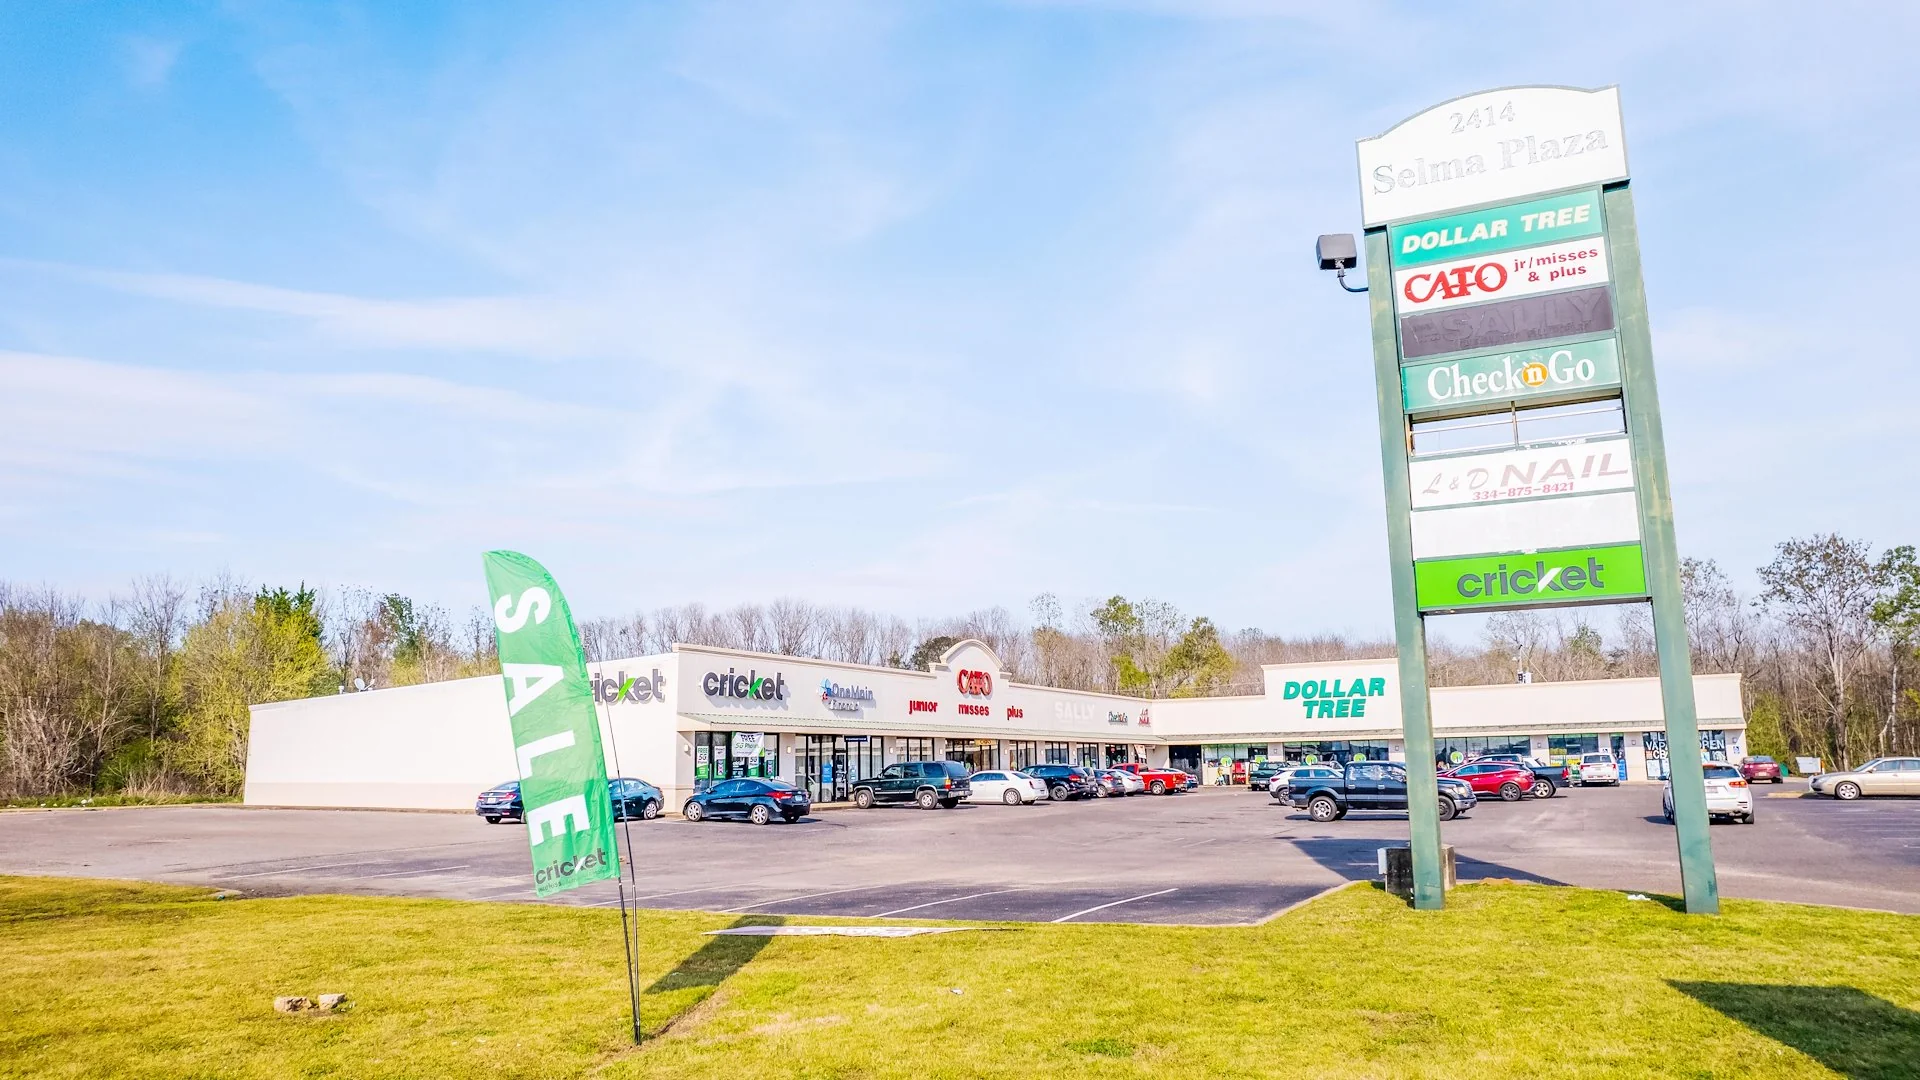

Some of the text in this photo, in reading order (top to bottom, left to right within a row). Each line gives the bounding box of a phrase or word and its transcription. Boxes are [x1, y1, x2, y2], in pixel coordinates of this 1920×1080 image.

[1450, 101, 1516, 134] 2414
[1373, 129, 1609, 195] Selma Plaza
[1401, 204, 1591, 254] DOLLAR TREE
[1404, 262, 1508, 303] CATO
[1528, 264, 1587, 282] & plus
[1500, 453, 1629, 487] NAIL
[1472, 481, 1575, 501] 334-875-8421
[1457, 557, 1605, 598] cricket
[590, 669, 663, 702] icket
[703, 667, 784, 700] cricket
[957, 669, 993, 696] CATO
[1283, 677, 1386, 700] DOLLAR
[494, 586, 590, 847] SALE
[909, 700, 1023, 720] junior misses plus
[1055, 701, 1095, 720] SALLY
[1303, 698, 1366, 718] TREE
[1652, 750, 1669, 760] CB
[1700, 739, 1725, 750] PEN
[535, 847, 607, 884] cricket
